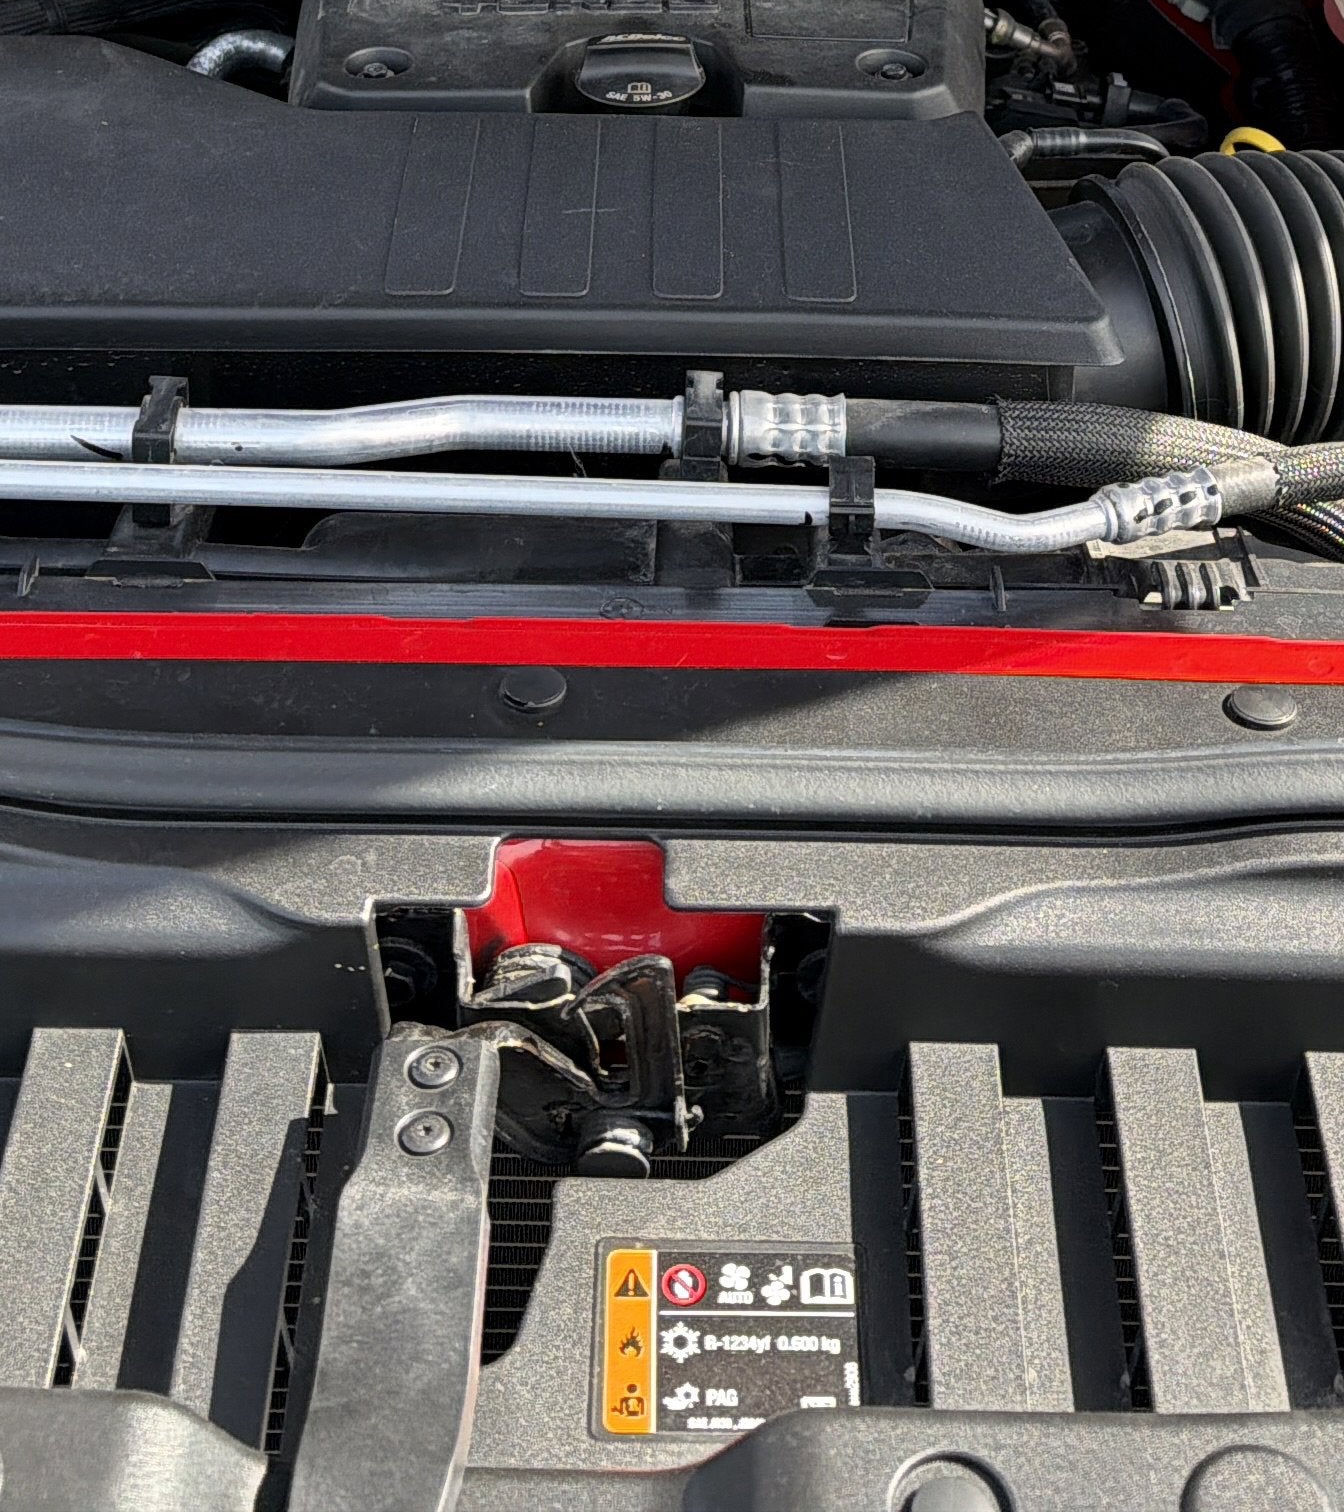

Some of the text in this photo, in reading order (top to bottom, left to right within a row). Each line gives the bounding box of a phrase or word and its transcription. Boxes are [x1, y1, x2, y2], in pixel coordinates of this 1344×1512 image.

[605, 89, 673, 102] SAE 5W-30
[717, 1291, 754, 1304] AUTO
[821, 1335, 841, 1355] kg
[705, 1388, 739, 1406] PAG
